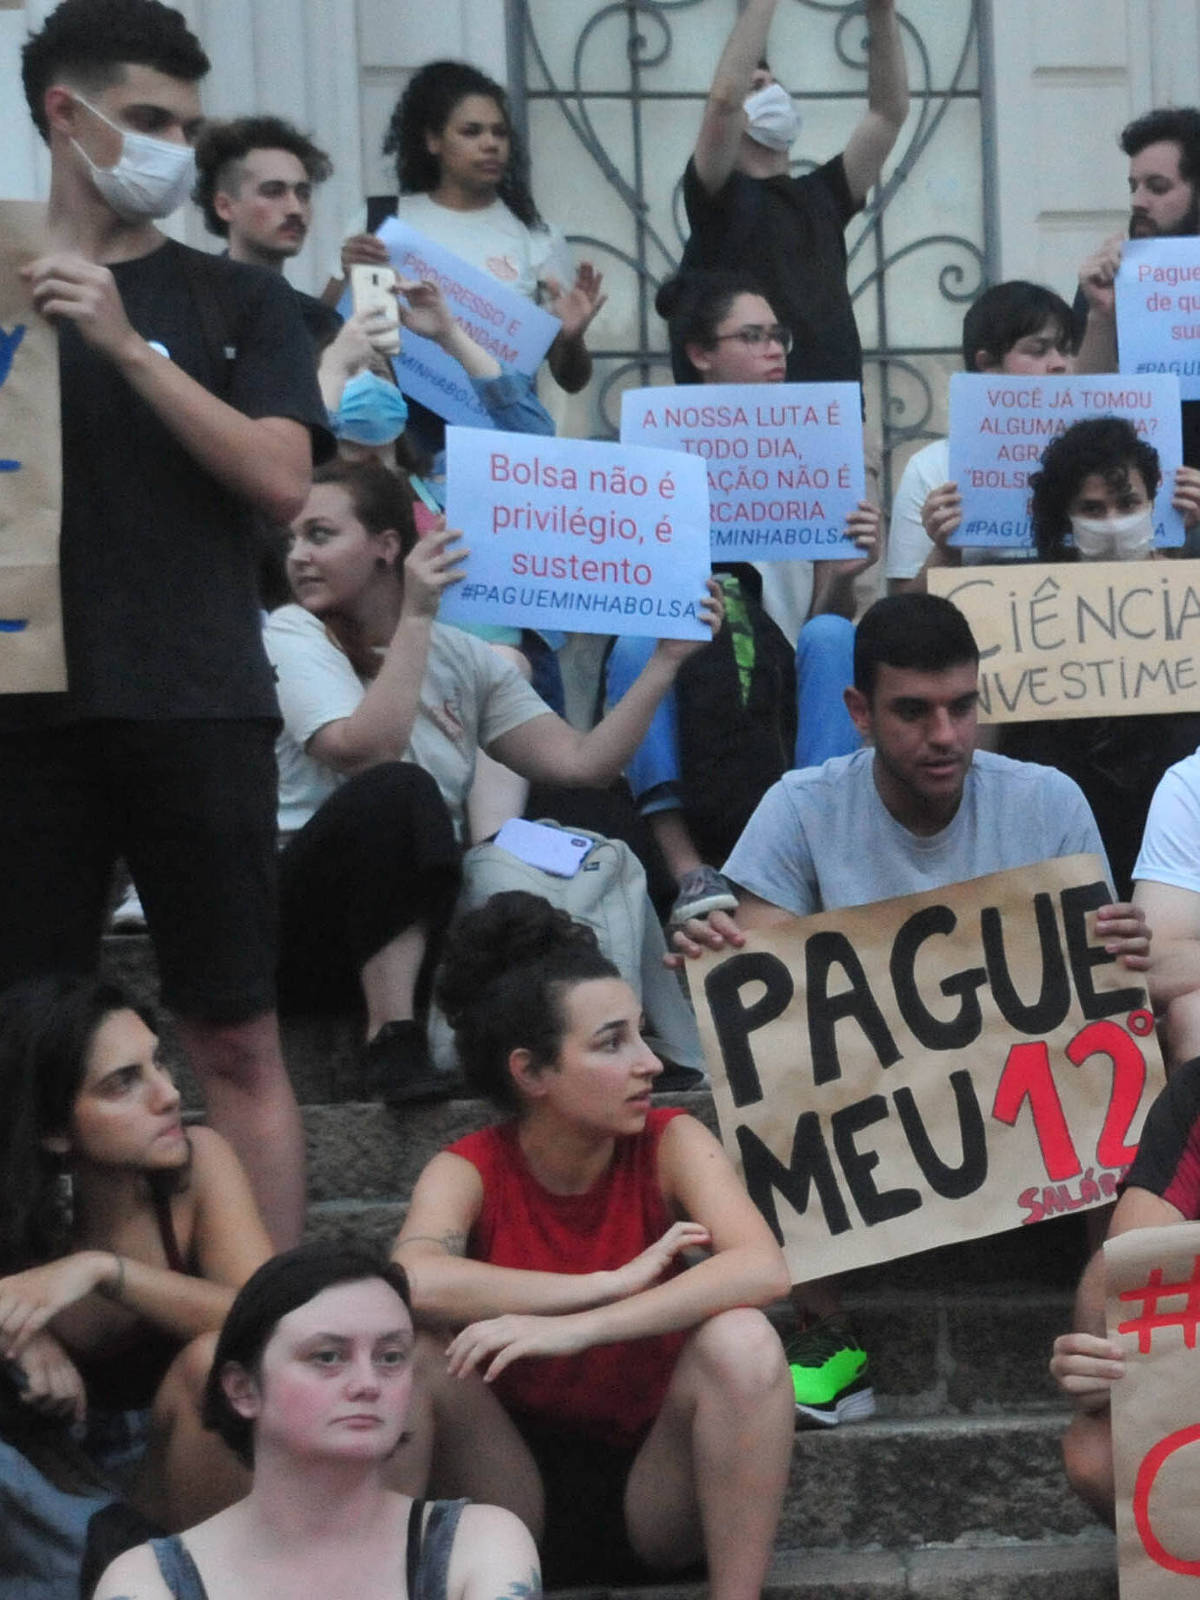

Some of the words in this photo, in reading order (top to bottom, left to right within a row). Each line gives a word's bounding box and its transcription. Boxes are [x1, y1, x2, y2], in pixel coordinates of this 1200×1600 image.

[1146, 293, 1172, 312] de
[507, 320, 522, 337] E
[987, 387, 1043, 409] VOCÊ
[1048, 387, 1074, 409] JÁ
[1082, 391, 1153, 409] TOMOU
[642, 409, 658, 428] A
[665, 406, 749, 428] NOSSA
[756, 406, 819, 426] LUTA
[827, 401, 842, 426] É
[979, 417, 1066, 436] ALGUMA
[681, 438, 749, 461] TODO
[757, 438, 803, 461] DIA,
[490, 453, 578, 490] Bolsa
[589, 465, 648, 497] não
[658, 472, 676, 499] é
[707, 464, 768, 496] AÇÃO
[778, 463, 830, 490] NÃO
[838, 463, 852, 490] É
[491, 502, 645, 545] privilégio,
[655, 517, 673, 543] é
[709, 501, 826, 523] RCADORIA
[512, 552, 653, 586] sustento
[460, 584, 697, 619] #PAGUEMINHABOLSA
[703, 881, 1147, 1108] PAGUE
[735, 1068, 988, 1248] MEU
